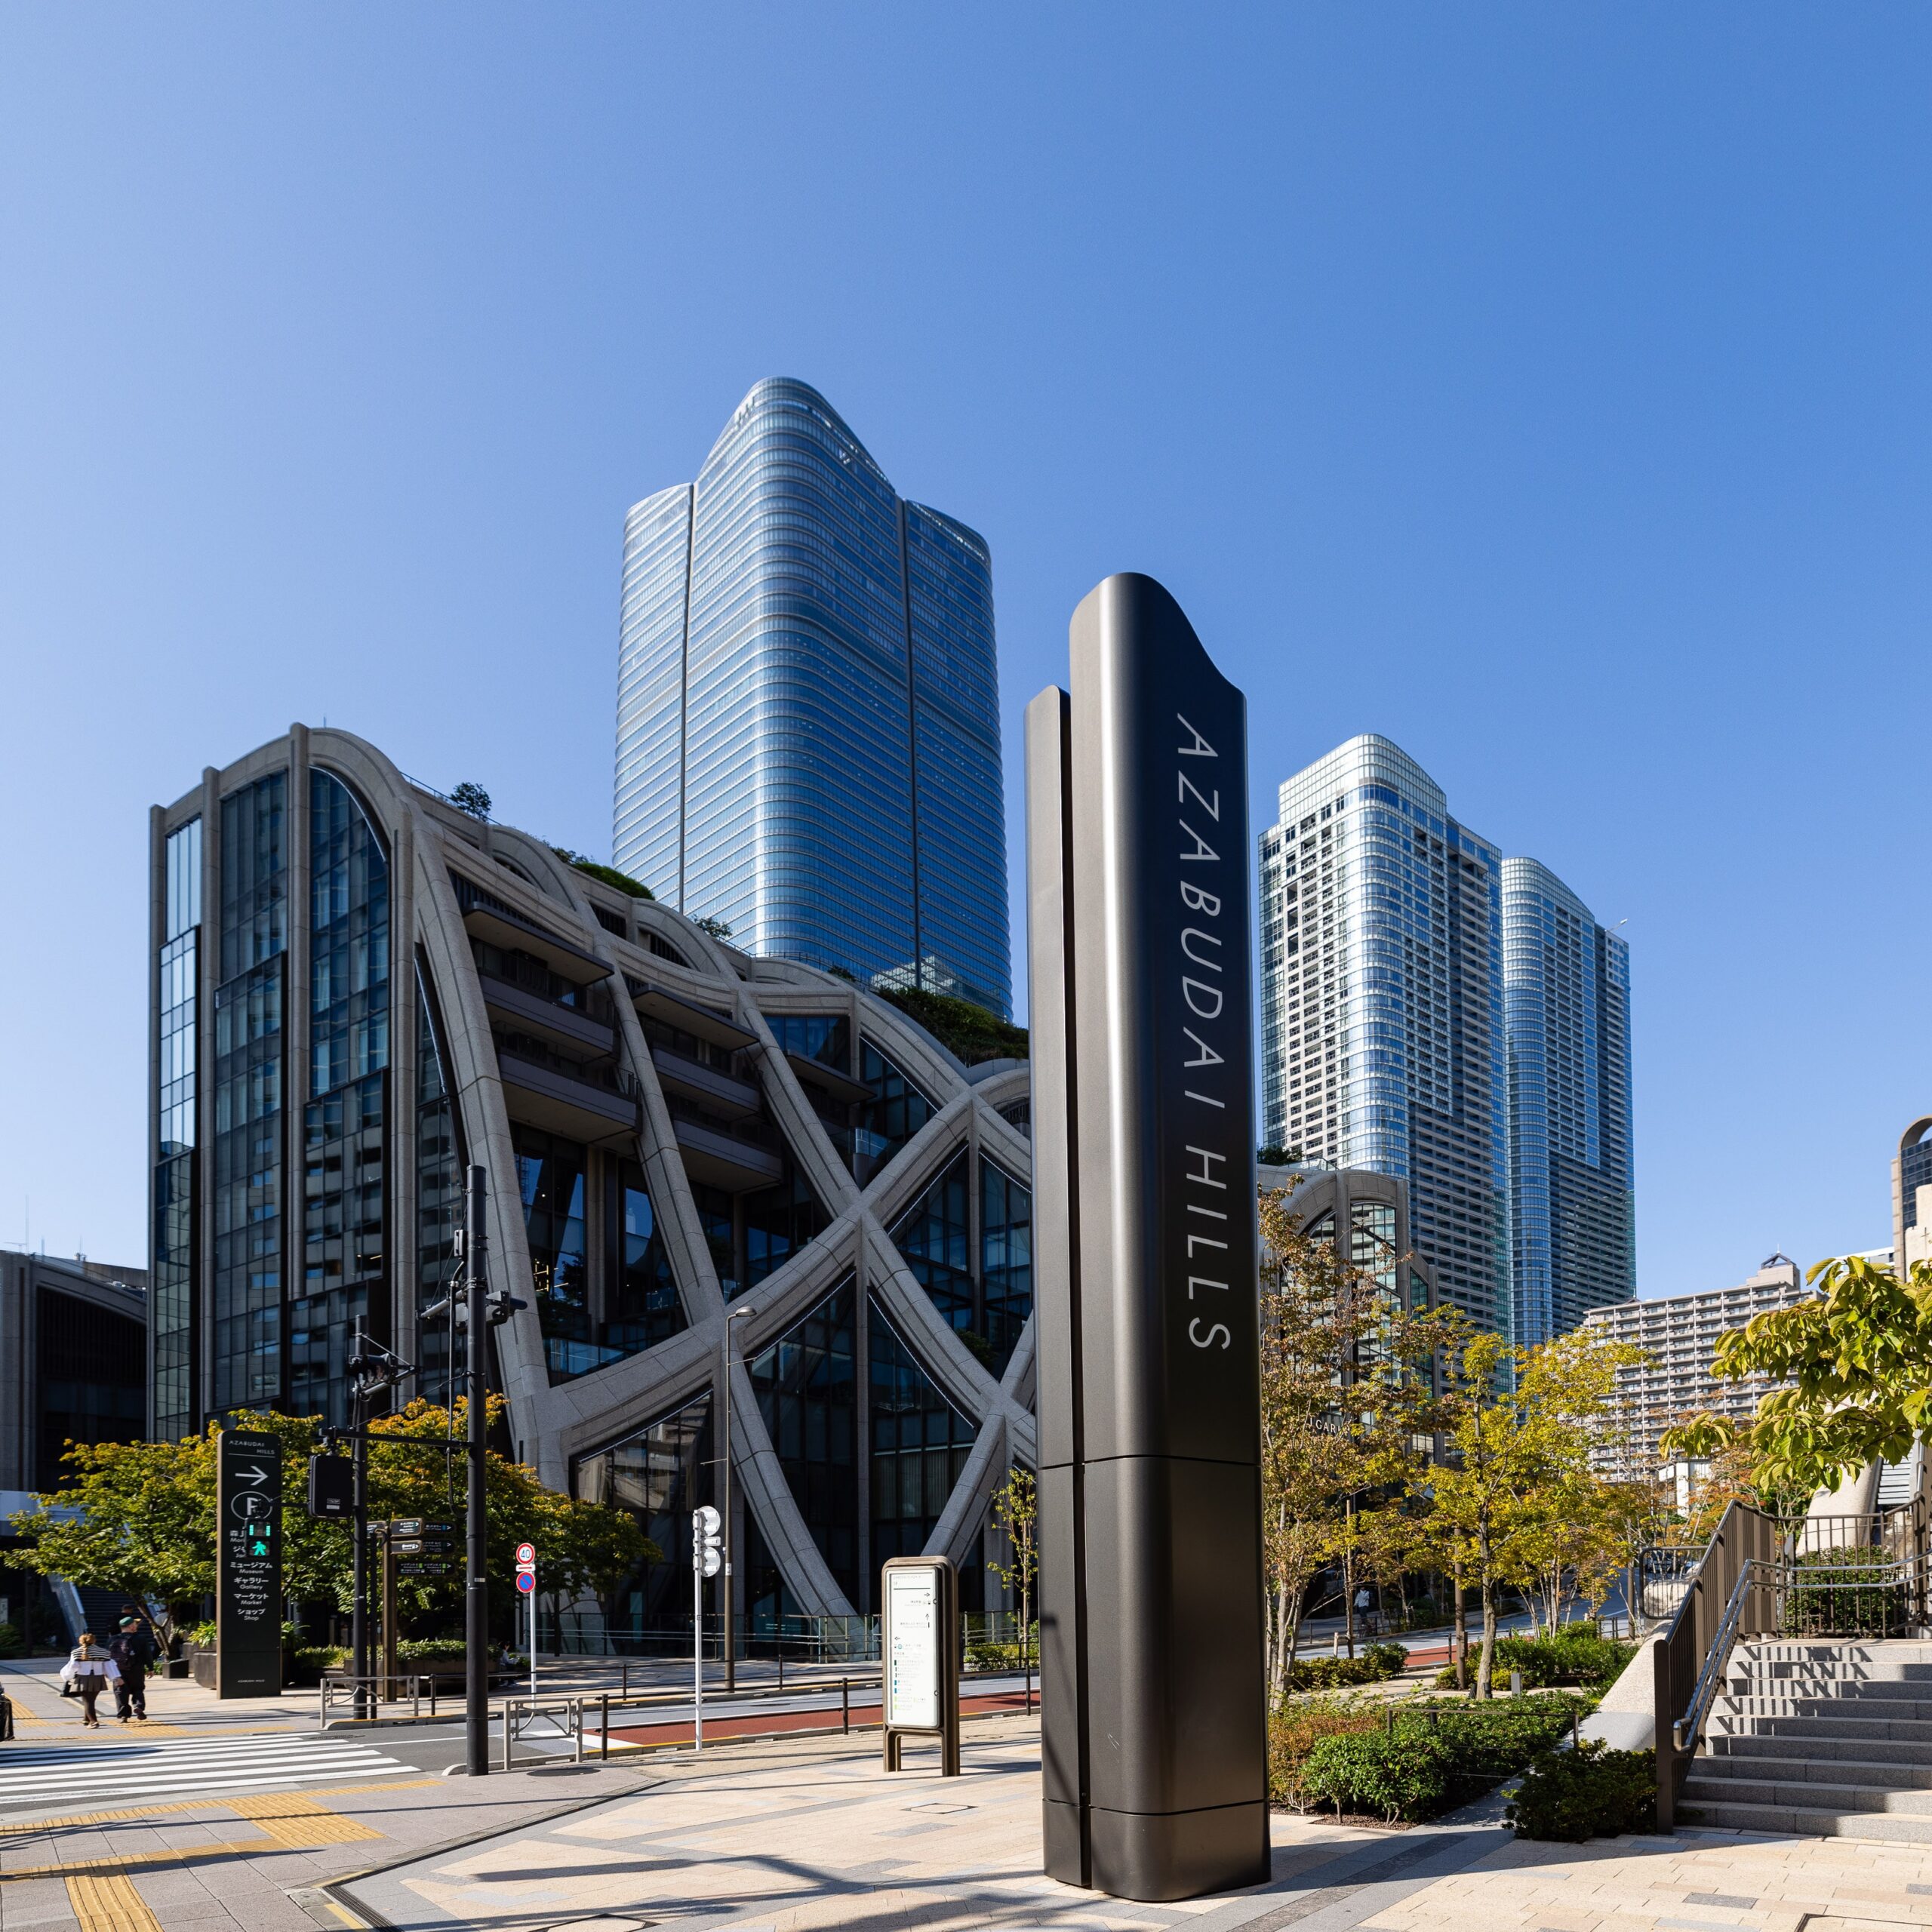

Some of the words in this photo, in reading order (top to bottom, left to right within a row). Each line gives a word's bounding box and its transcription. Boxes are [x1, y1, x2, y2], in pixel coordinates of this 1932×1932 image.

[1177, 712, 1226, 1109] AZABUDAI
[1186, 1144, 1231, 1350] HILLS
[521, 1549, 531, 1559] 40
